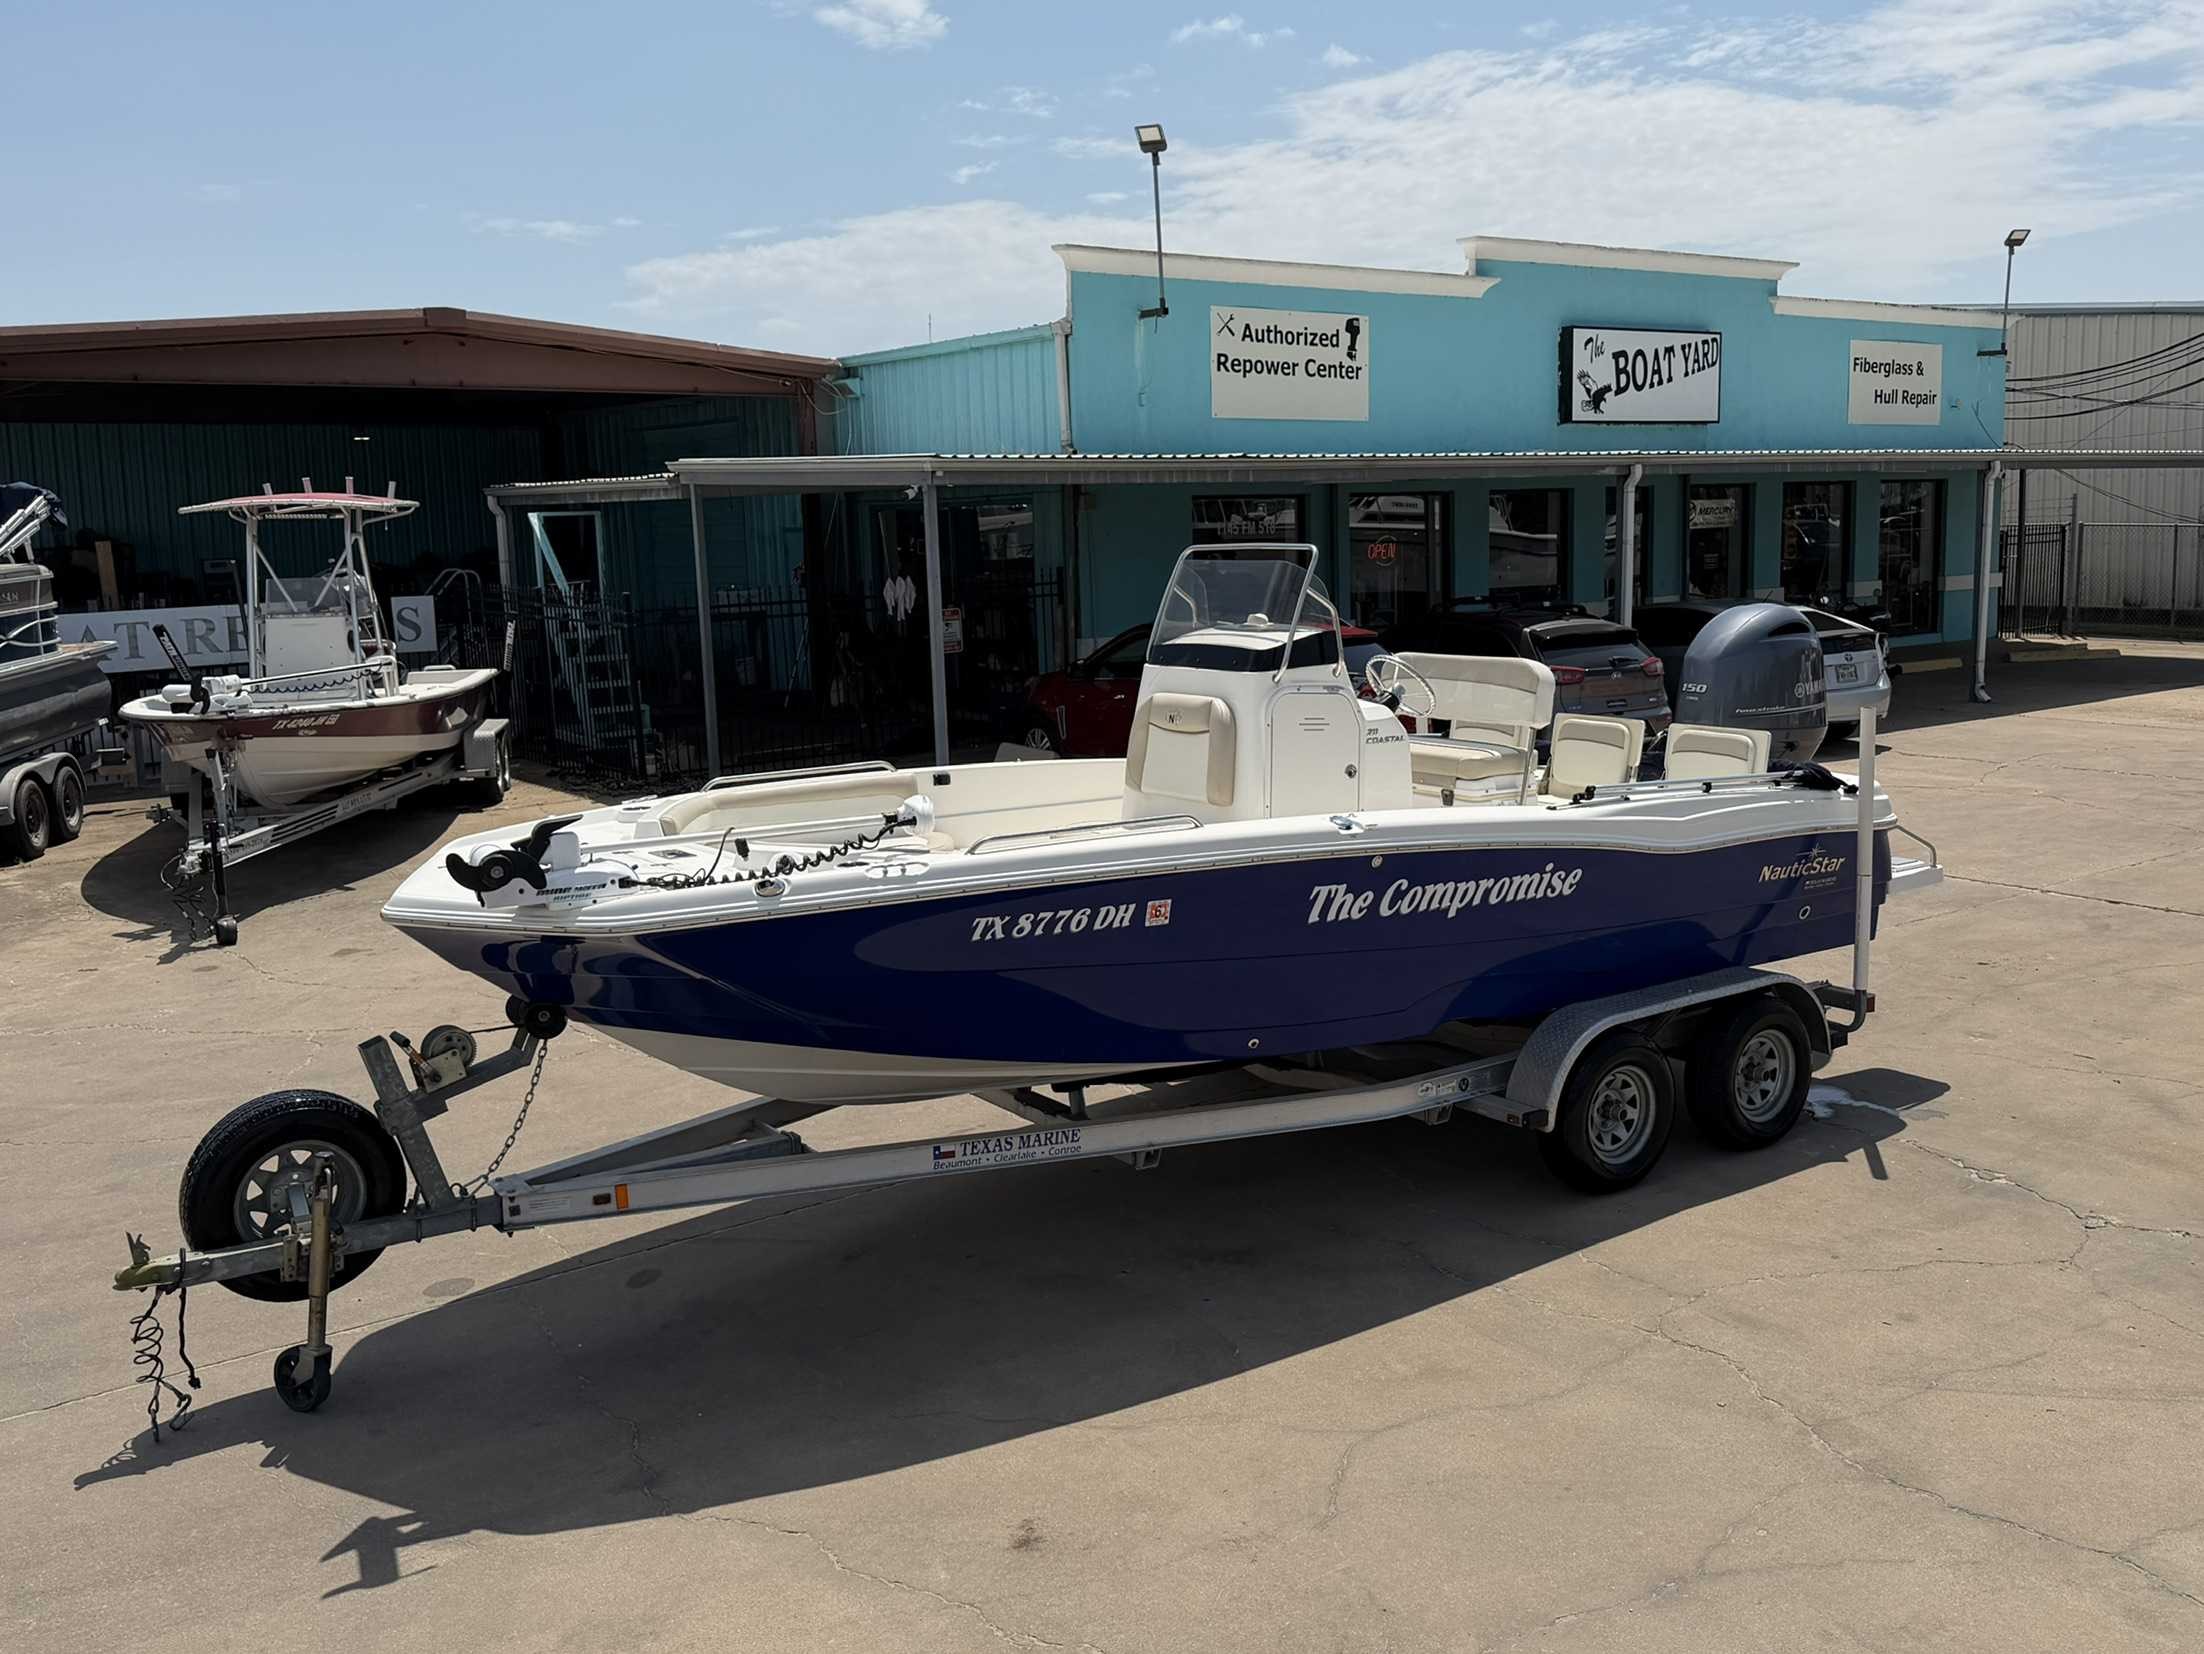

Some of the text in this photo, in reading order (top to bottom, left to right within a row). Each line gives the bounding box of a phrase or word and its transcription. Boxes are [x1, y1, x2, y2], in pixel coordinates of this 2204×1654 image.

[1241, 323, 1340, 348] Authorized
[1584, 334, 1606, 363] The
[1216, 352, 1362, 380] Repower Center
[1611, 337, 1719, 397] BOAT YARD
[1853, 357, 1925, 378] Fiberglass &
[1874, 388, 1937, 408] Hull Repair
[1367, 543, 1397, 560] OPEN
[1681, 683, 1708, 694] 150
[1366, 735, 1406, 744] COASTAL
[1758, 855, 1845, 883] NauticStar
[1307, 862, 1583, 924] The Compromise
[971, 903, 1136, 942] TX 8776 DH
[960, 1128, 1081, 1157] TEXAS MARINE
[933, 1144, 1082, 1170] Beaumont Clearlake Conroe
